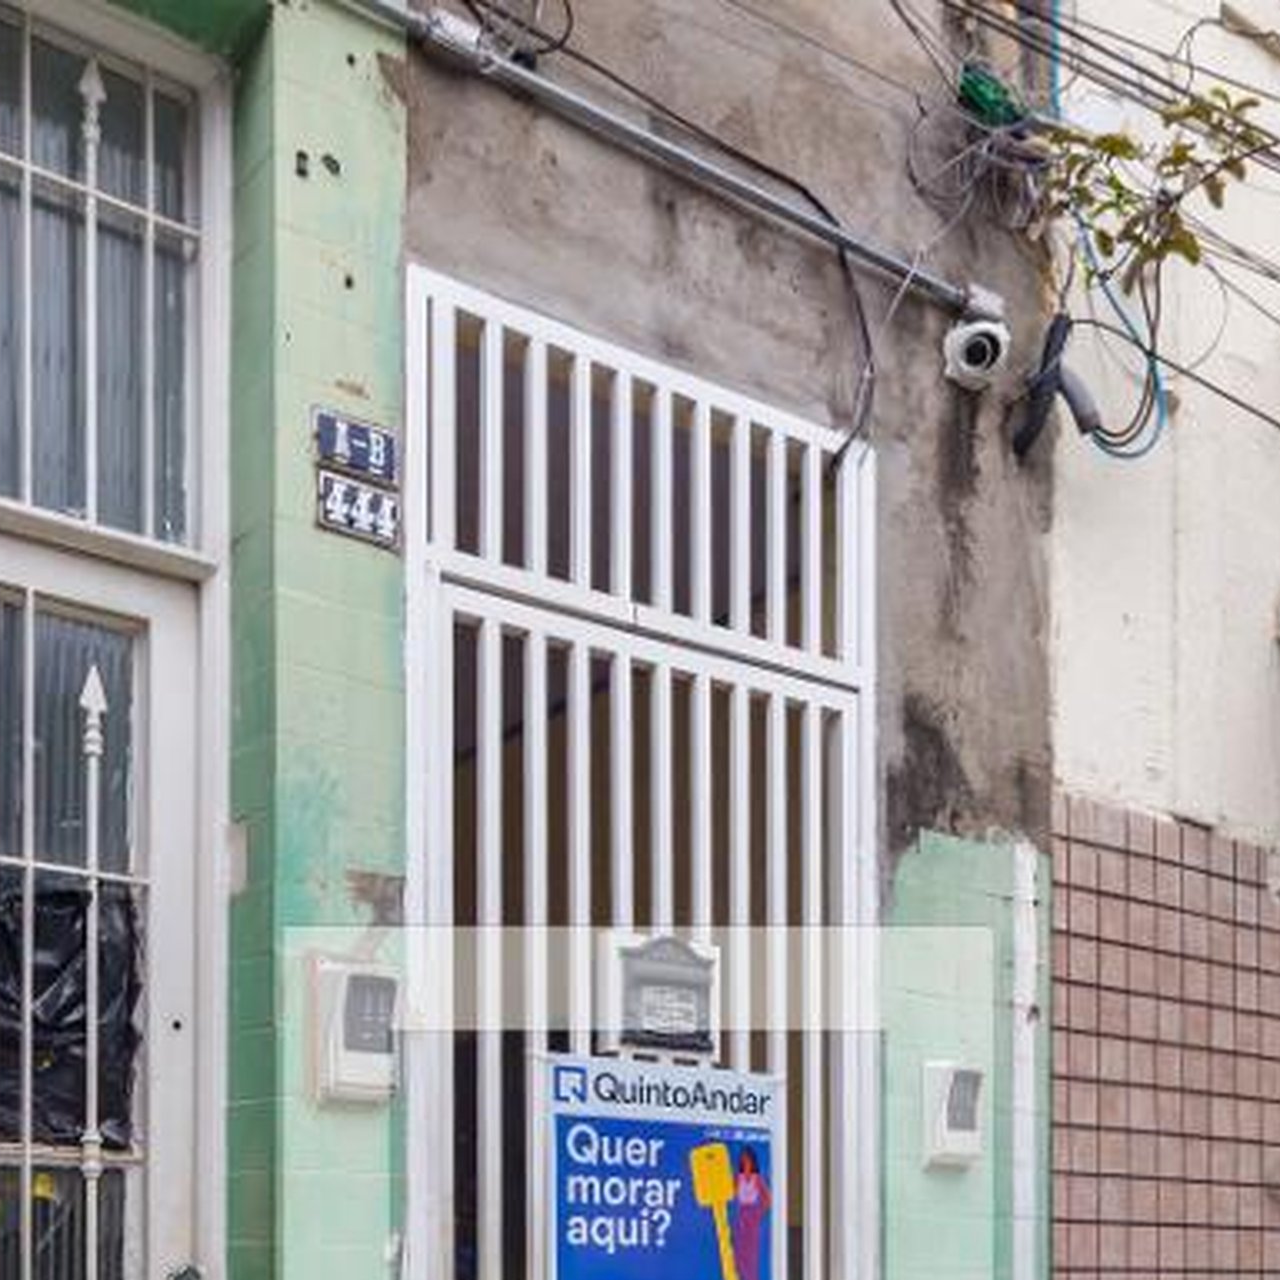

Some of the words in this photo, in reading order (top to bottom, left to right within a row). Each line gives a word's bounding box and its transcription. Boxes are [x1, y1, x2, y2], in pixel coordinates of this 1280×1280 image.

[592, 1071, 771, 1116] QuintoAndar
[565, 1123, 665, 1168] Quer
[565, 1173, 682, 1208] morar
[565, 1209, 672, 1254] aqui?
